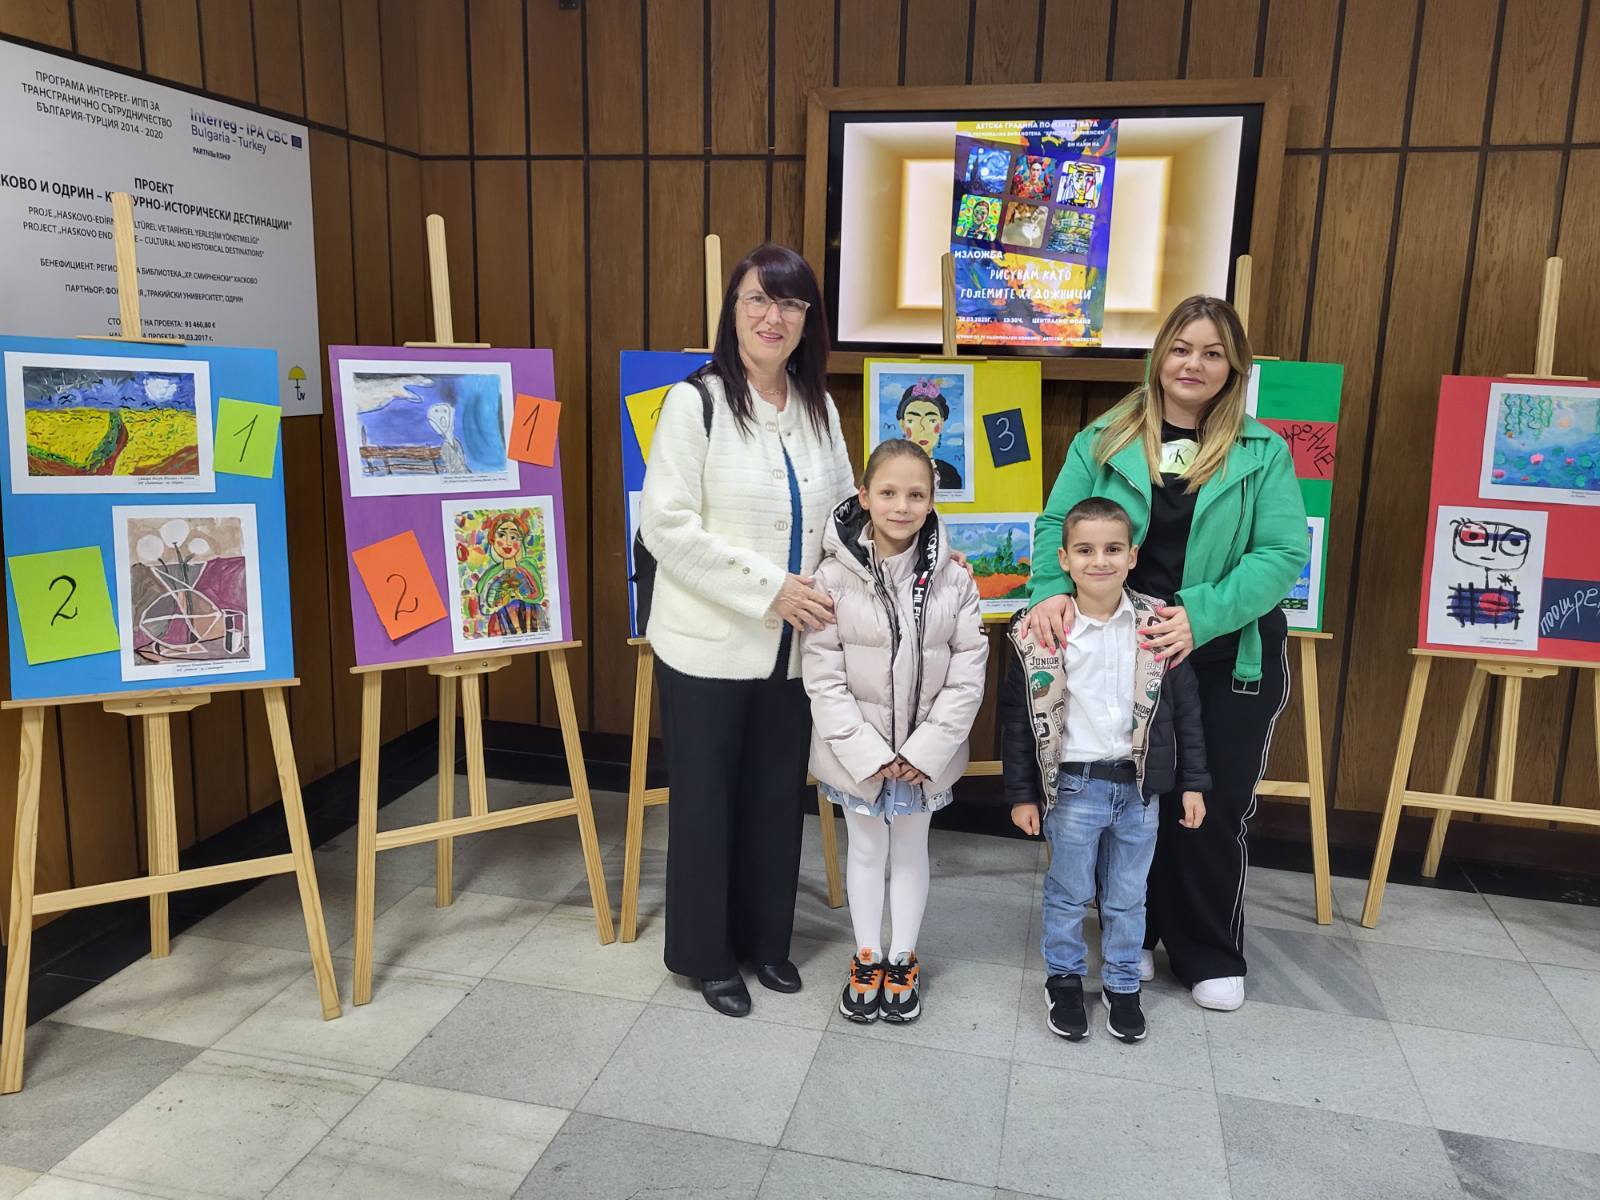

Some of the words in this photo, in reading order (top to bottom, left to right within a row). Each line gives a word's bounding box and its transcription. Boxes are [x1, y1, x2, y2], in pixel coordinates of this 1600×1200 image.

[21, 82, 99, 110] ТРАНСГРАНИЧНО
[101, 102, 172, 128] СЪТРУДНИЧЕСТВО
[35, 71, 85, 92] ПРОГРАМА
[86, 84, 130, 103] ИНТЕРРЕГ-
[131, 95, 149, 109] ИПП
[150, 101, 160, 112] ЗА
[36, 101, 119, 129] БЪЛГАРИЯ-ТУРЦИЯ
[120, 121, 139, 134] 2014
[145, 127, 163, 139] 2020
[190, 107, 237, 133] Interreg
[246, 121, 265, 140] IPA
[266, 127, 289, 145] CBC
[191, 124, 230, 143] Bulgaria
[238, 136, 267, 155] Turkey
[0, 173, 37, 191] КОВО
[40, 180, 49, 193] И
[52, 182, 94, 200] ОДРИН
[105, 190, 231, 222] КУРНО-ИСТОРИЧЕСКИ
[134, 177, 174, 195] ПРОЕКТ
[28, 206, 53, 218] PROJE
[23, 221, 57, 234] PROJECT
[98, 230, 113, 241] END
[144, 236, 177, 249] CULTURAL
[177, 240, 191, 250] AND
[191, 242, 223, 254] HISTORICAL
[954, 250, 1004, 260] ИЗЛОЖБА
[40, 258, 95, 272] БЕНЕФИЦИЕНТ:
[1042, 269, 1071, 281] КАТО
[65, 284, 105, 295] ПАРТНЬОР:
[960, 287, 1015, 300] ГОЛЕМИТЕ
[233, 413, 258, 463] 1
[522, 403, 541, 452] 1
[994, 416, 1017, 453] 3
[48, 574, 79, 626] 2
[386, 573, 419, 621] 2
[1029, 656, 1060, 667] JUNIOR
